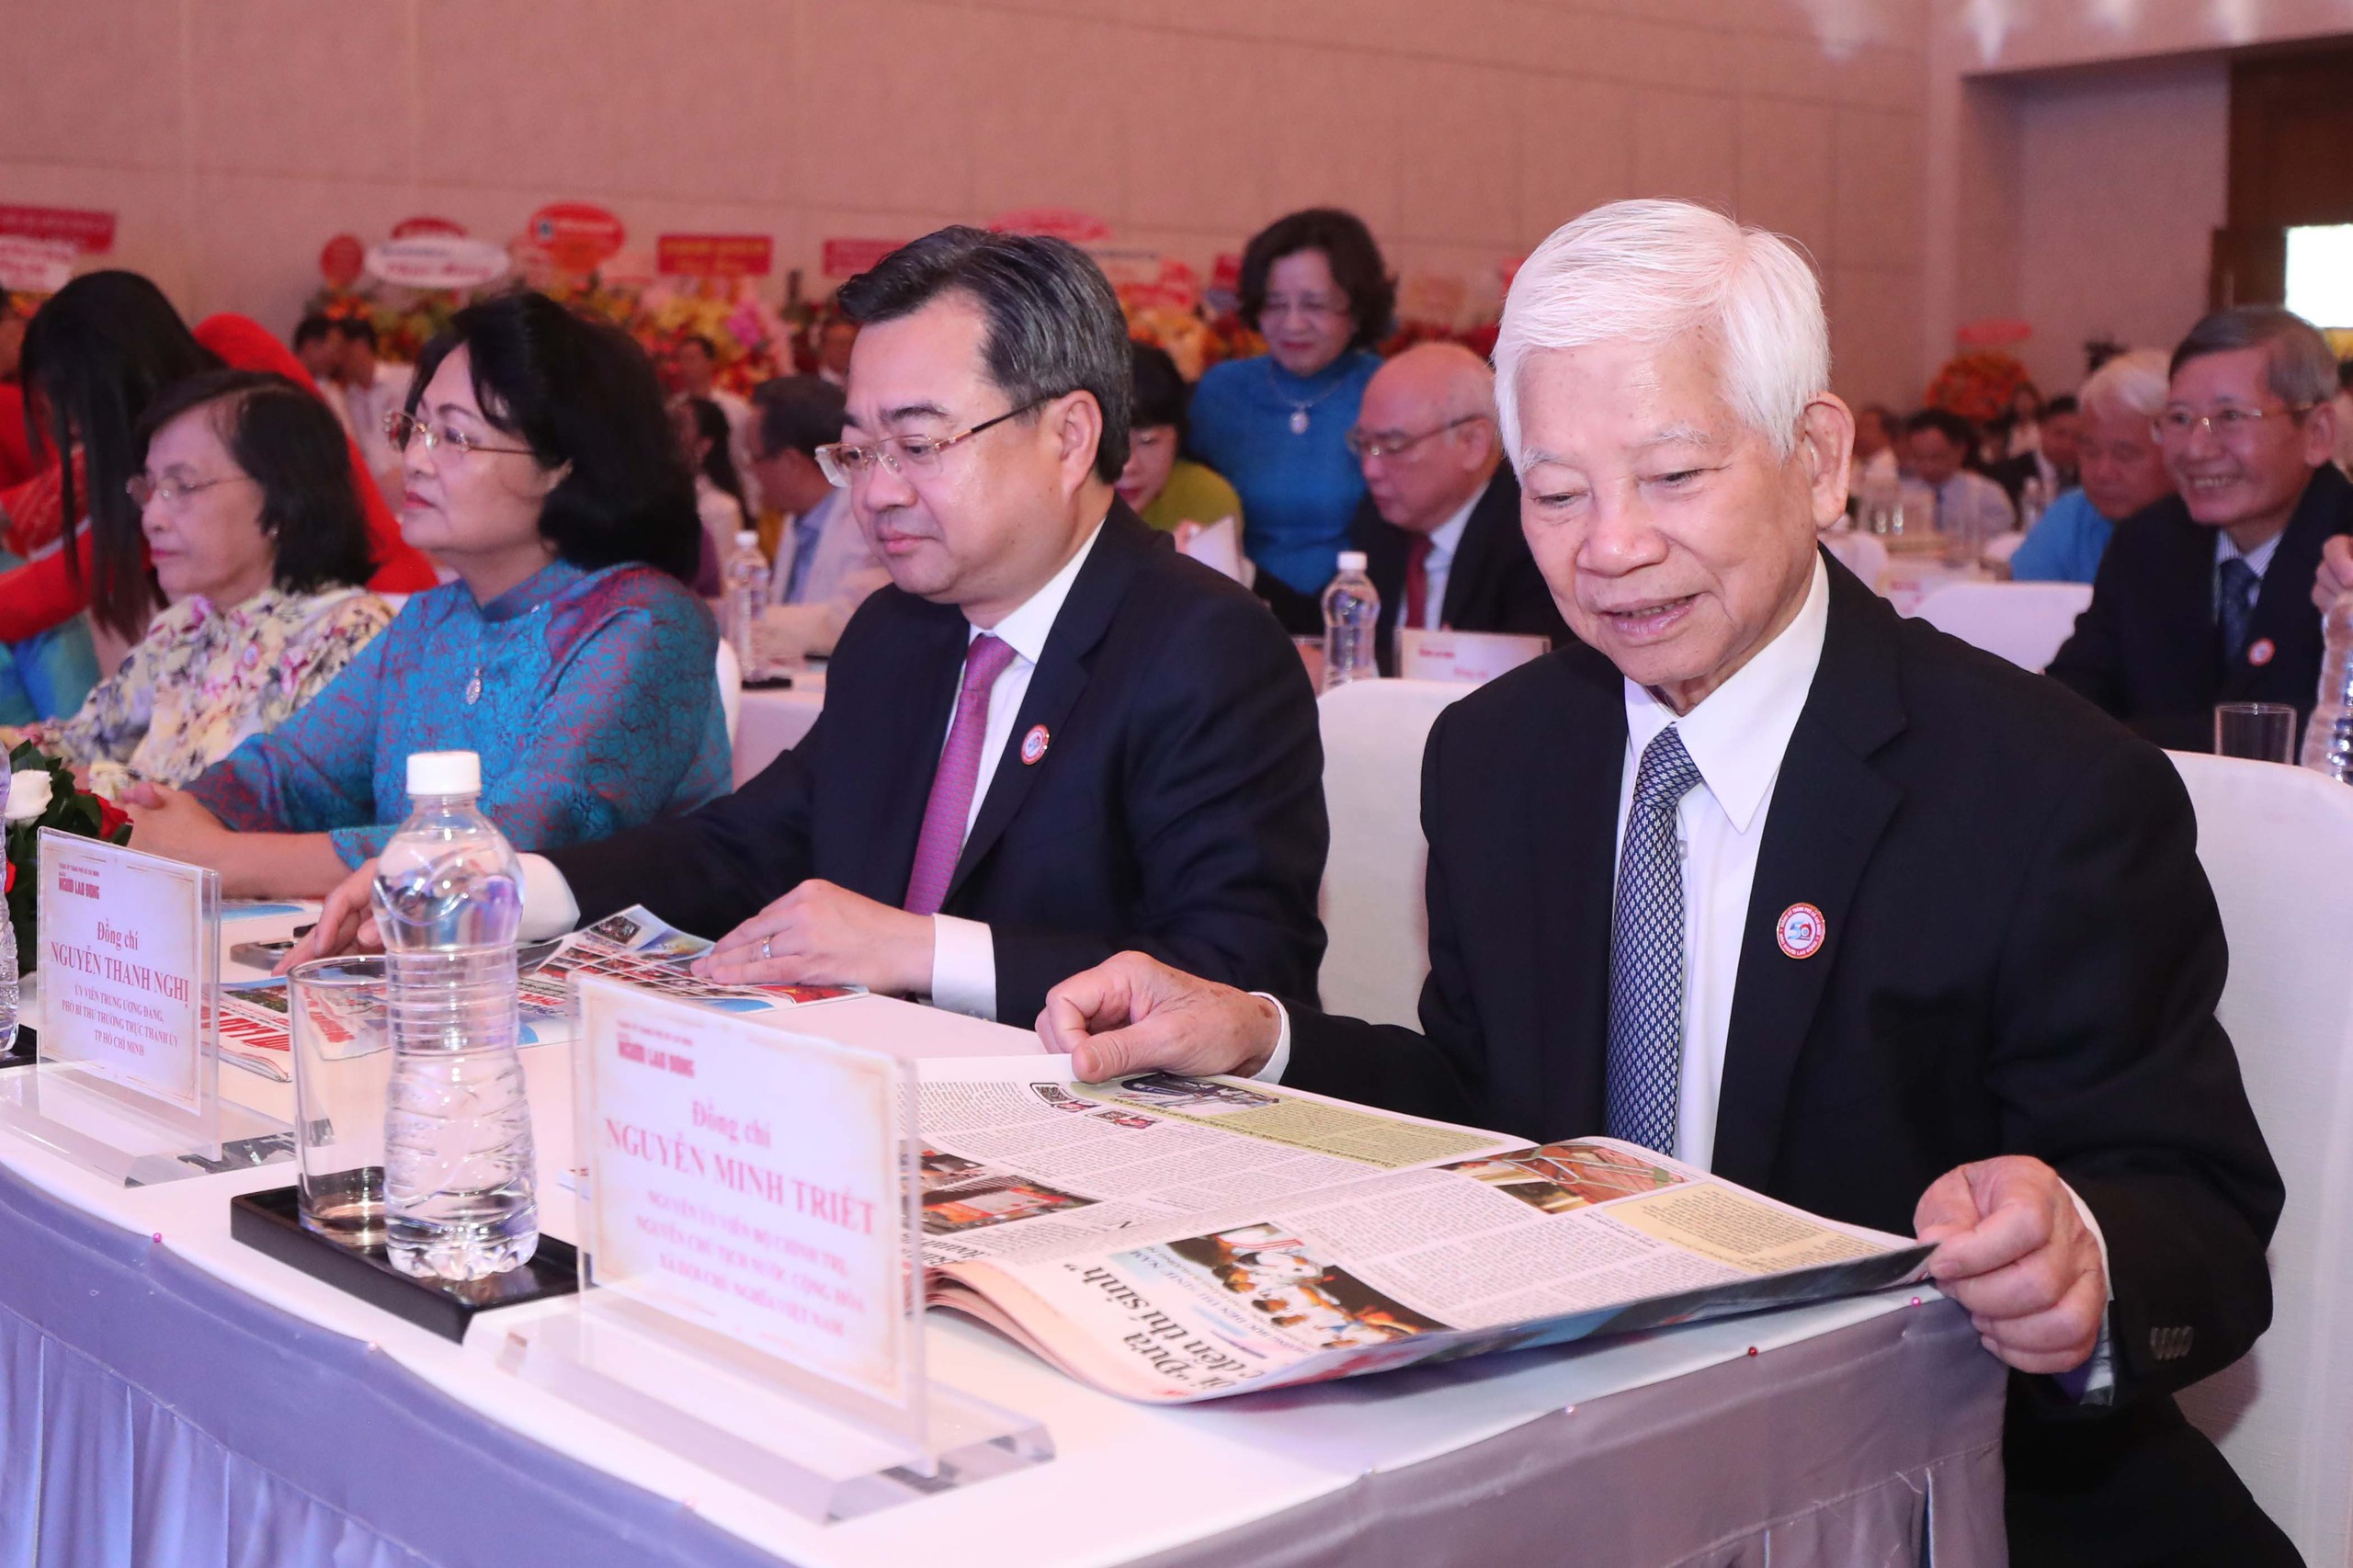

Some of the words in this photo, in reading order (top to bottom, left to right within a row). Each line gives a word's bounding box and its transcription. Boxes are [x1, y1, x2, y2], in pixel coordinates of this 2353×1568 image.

[97, 917, 121, 951] Đồng
[124, 929, 138, 950] chí
[51, 941, 101, 975] NGUYỄN
[104, 957, 150, 991] THANH
[153, 971, 188, 1008] NGHỊ
[100, 992, 121, 1009] TRUNG
[95, 1029, 103, 1042] TP
[126, 1041, 144, 1056] MINH
[692, 1098, 738, 1144] Đồng
[745, 1119, 770, 1148] chí
[606, 1118, 705, 1177] NGUYỄN
[714, 1153, 783, 1205] MINH
[791, 1179, 875, 1235] TRIẾT
[1129, 1309, 1189, 1341] thí
